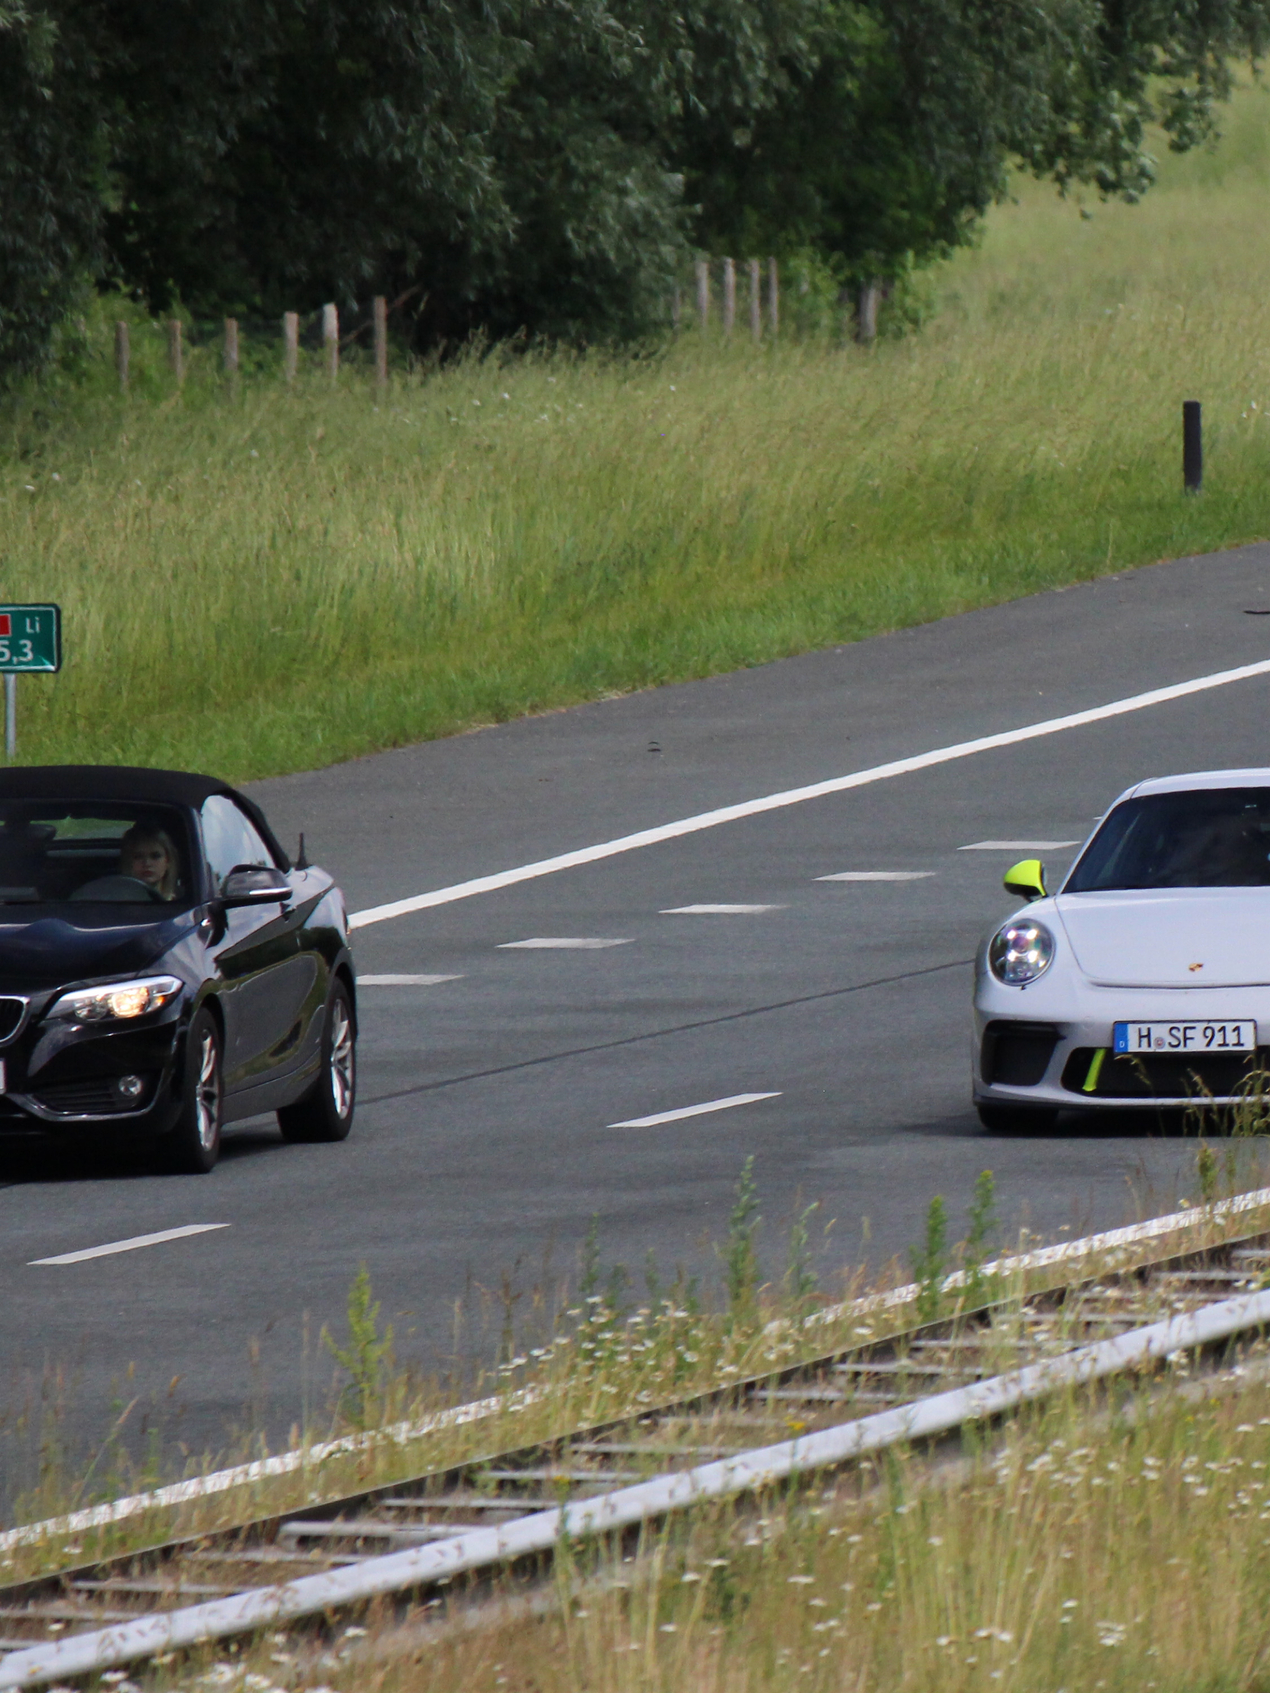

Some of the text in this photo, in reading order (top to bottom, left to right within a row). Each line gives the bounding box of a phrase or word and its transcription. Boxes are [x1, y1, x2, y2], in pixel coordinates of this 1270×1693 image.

[26, 616, 40, 633] Li
[1137, 1025, 1245, 1048] H SF 911
